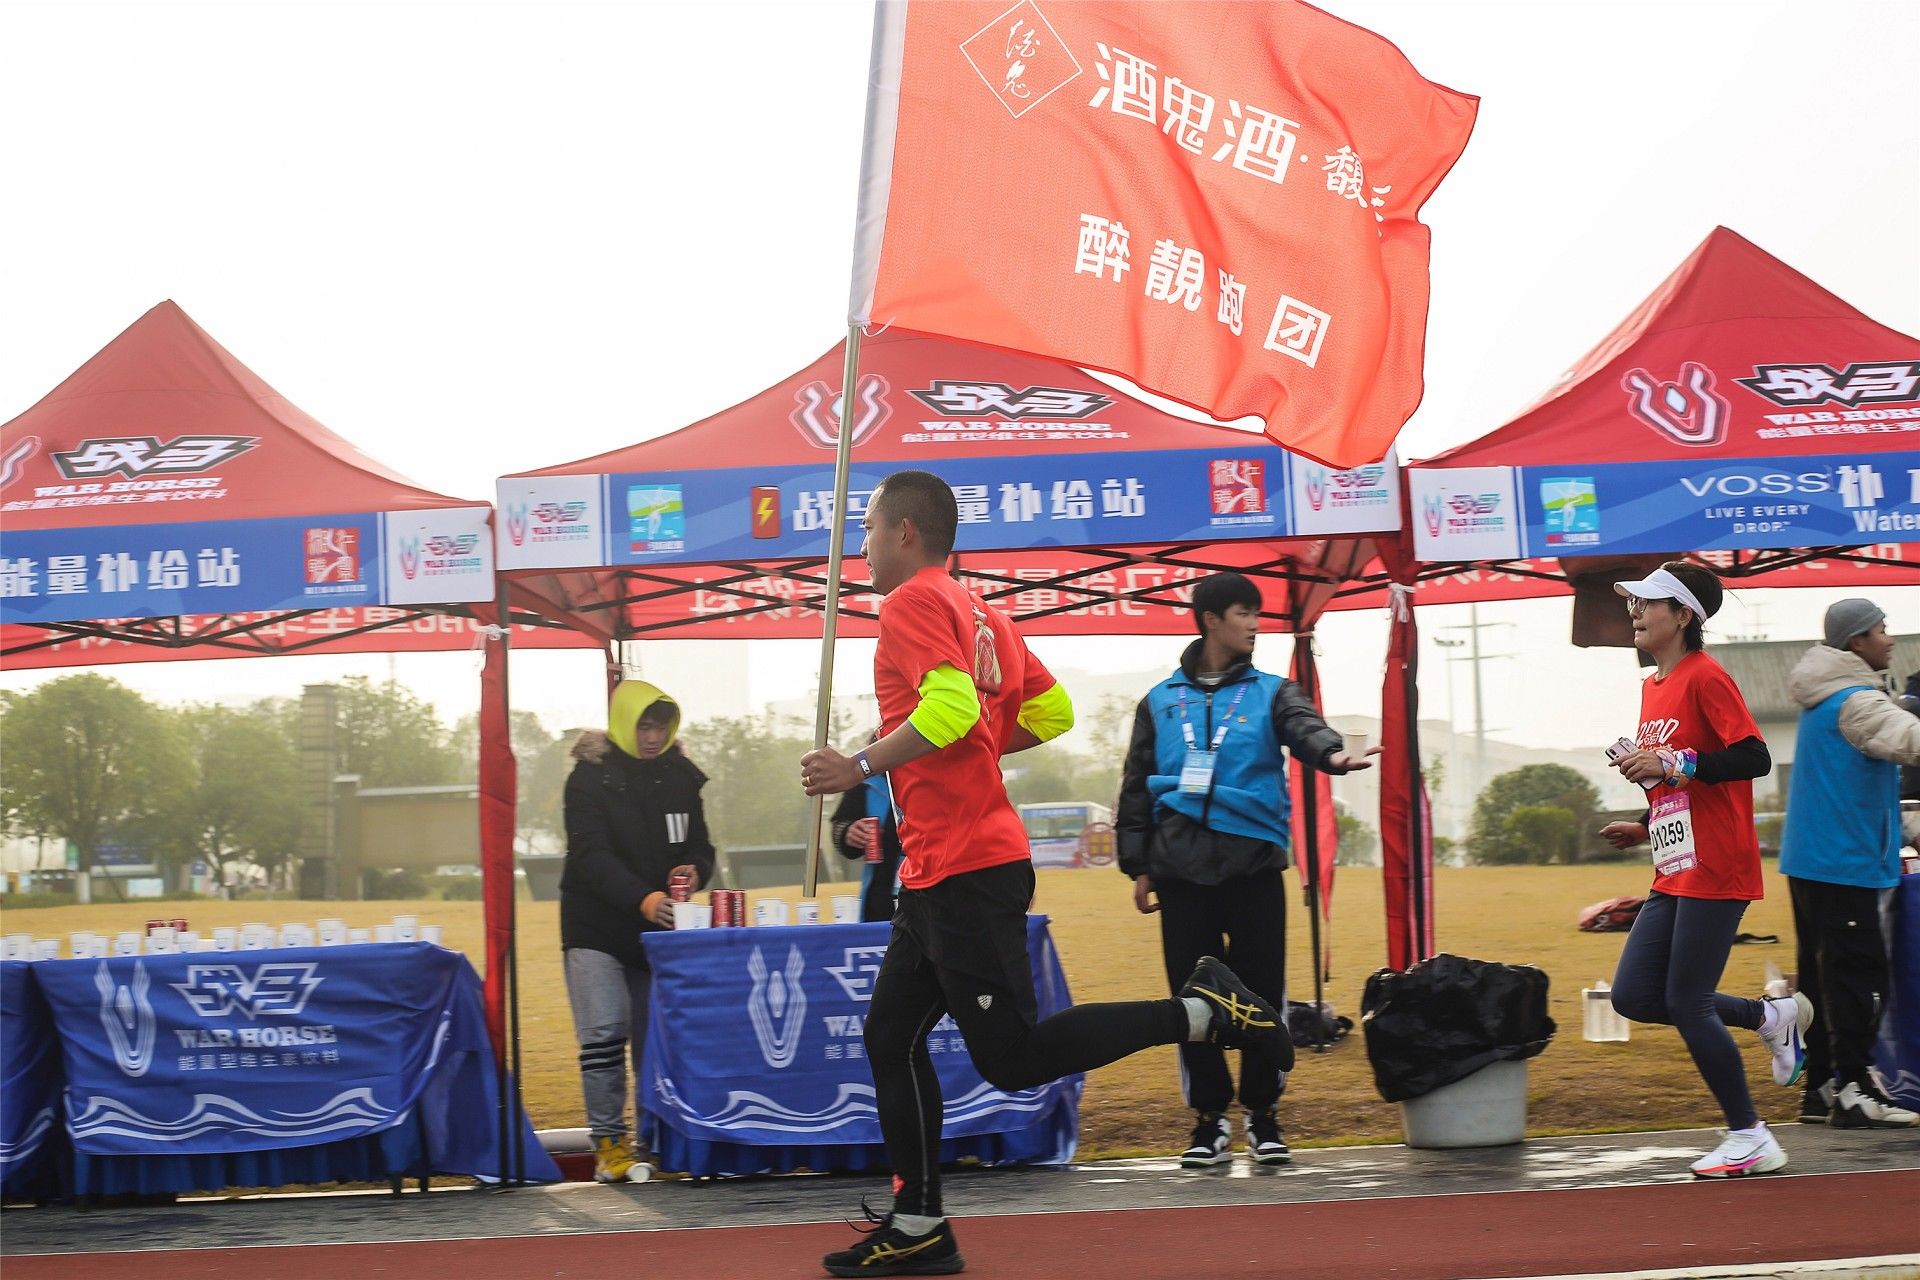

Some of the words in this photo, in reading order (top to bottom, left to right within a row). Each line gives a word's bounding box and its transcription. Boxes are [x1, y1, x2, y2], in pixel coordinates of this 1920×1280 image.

[919, 421, 992, 432] WAR
[996, 422, 1112, 432] HORSE
[1763, 412, 1836, 426] WAR
[34, 483, 102, 498] WAR
[103, 477, 223, 493] HORSE
[1679, 472, 1830, 497] VOSS
[1705, 507, 1746, 519] LIVE
[1752, 504, 1810, 517] EVERY
[0, 547, 241, 598] 能量补给站
[174, 1029, 237, 1049] WAR
[238, 1024, 338, 1048] HORSE
[822, 1014, 868, 1038] WA
